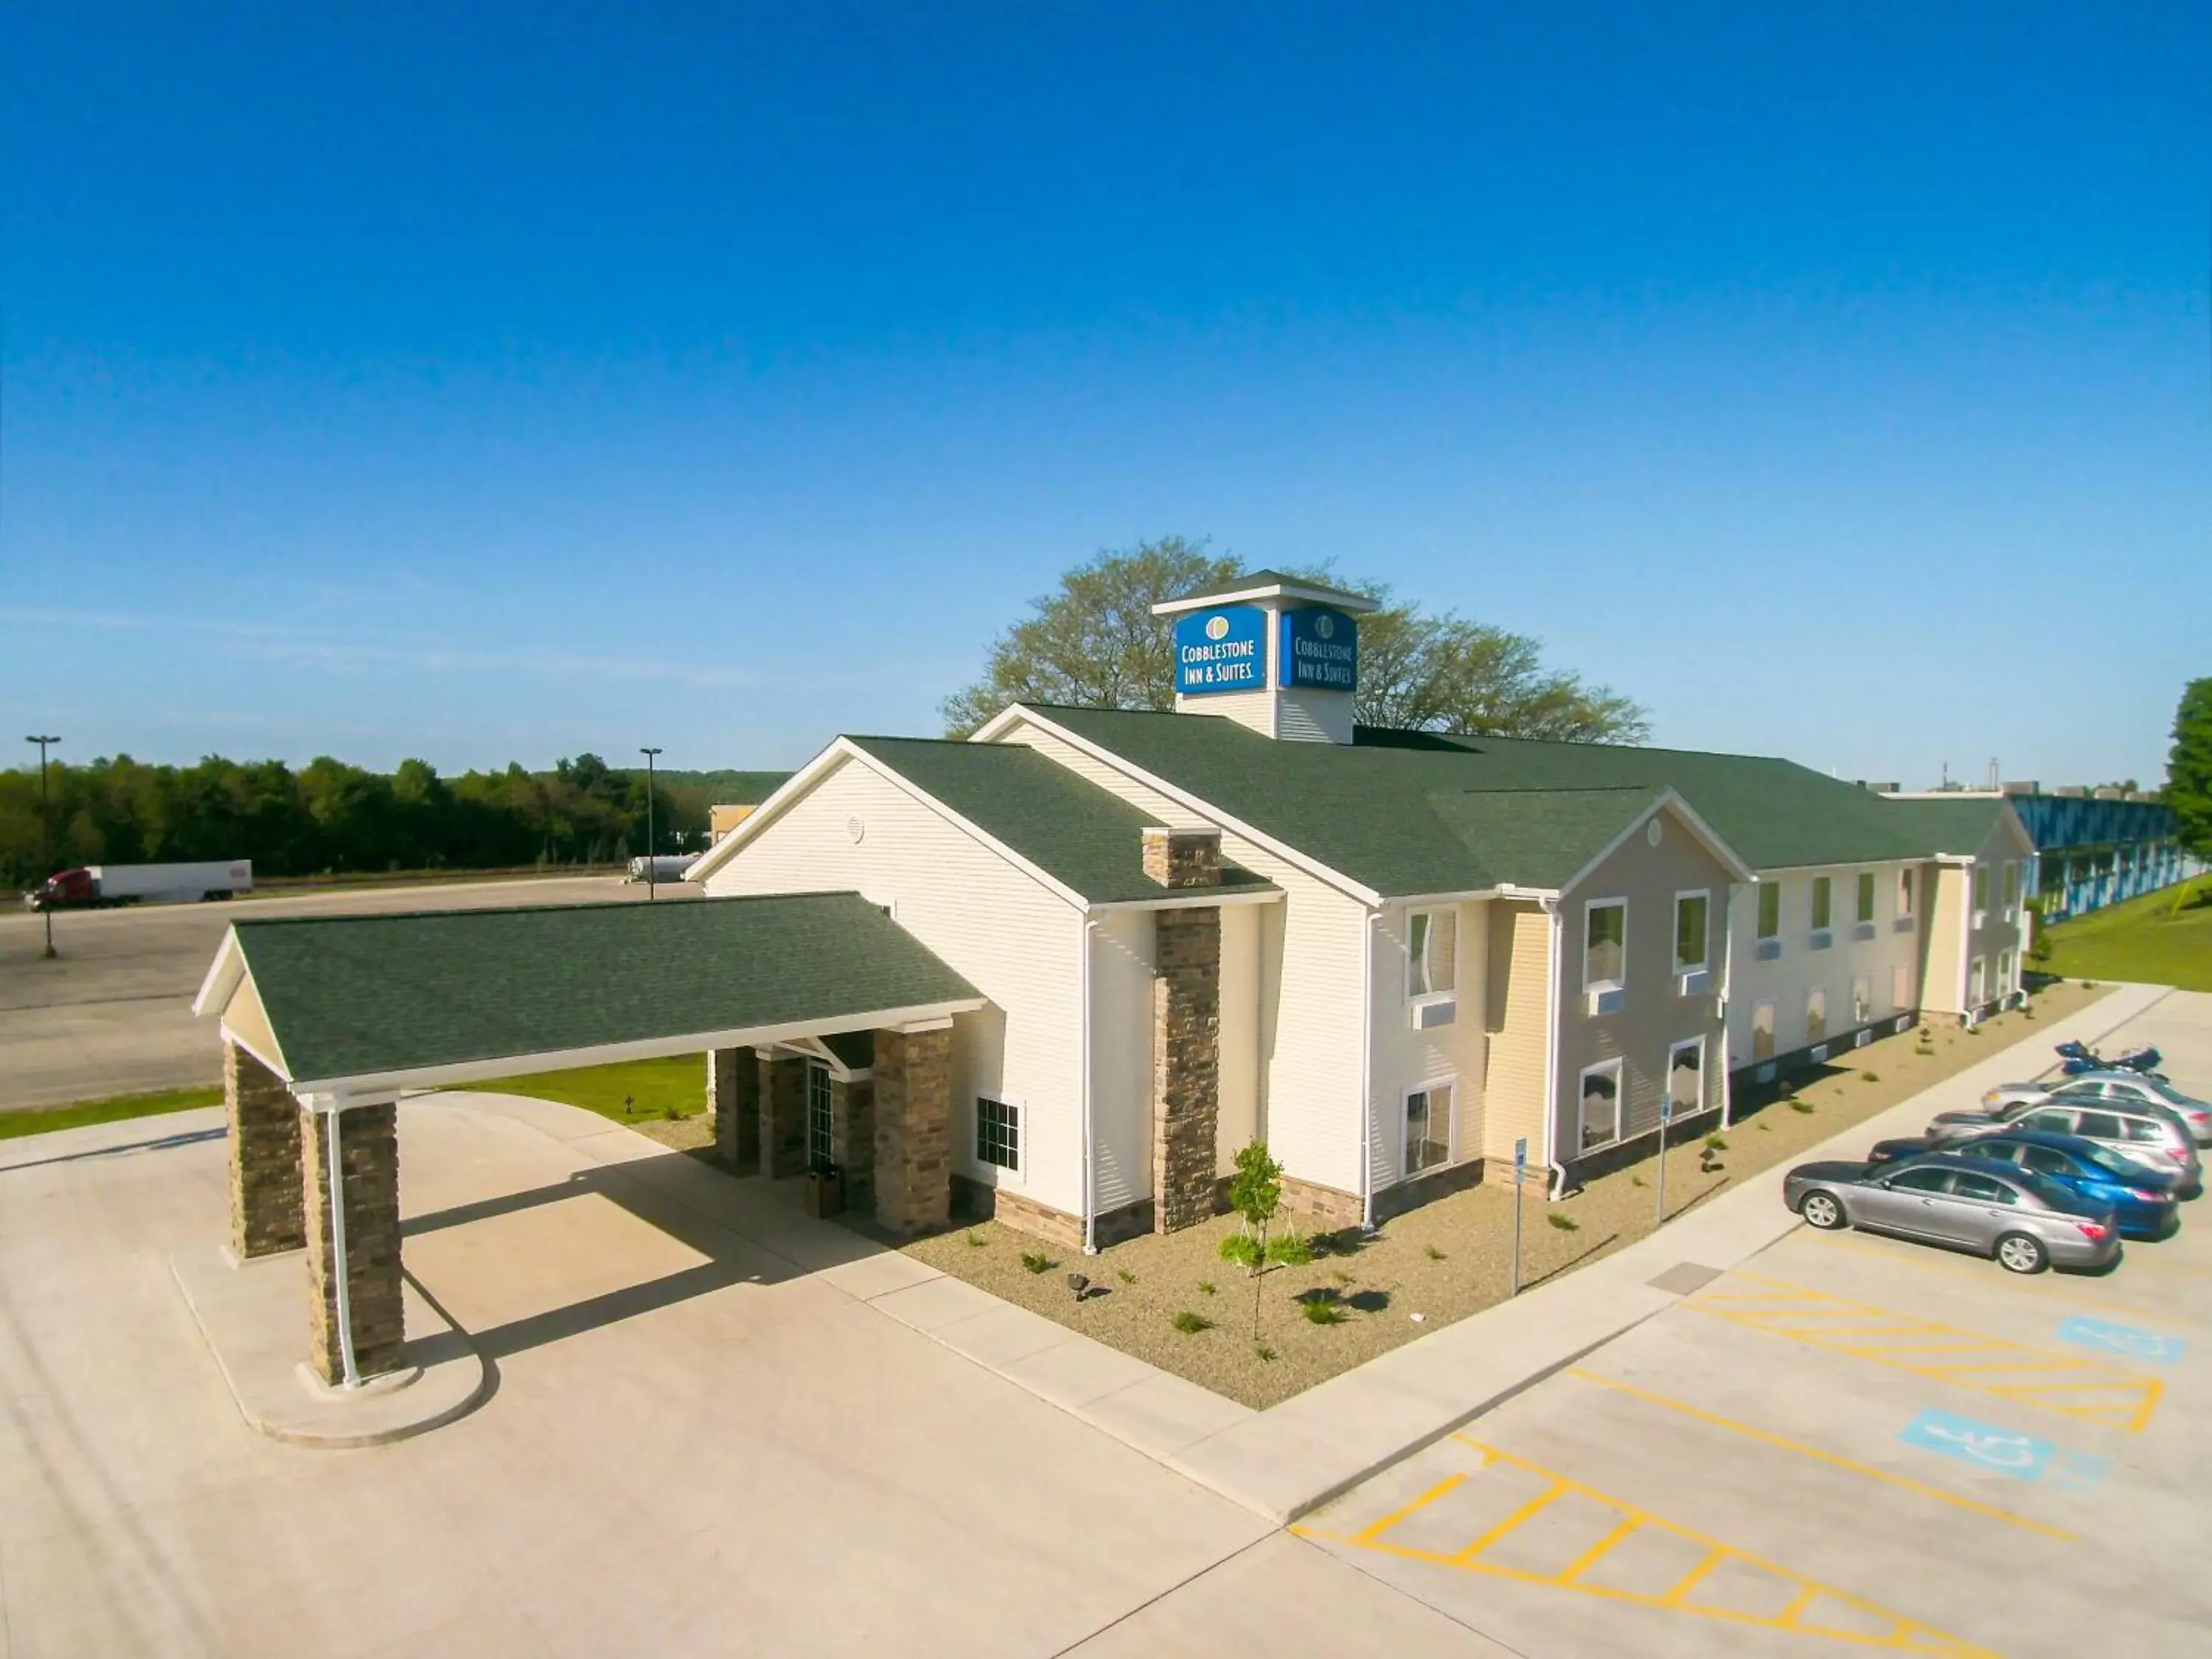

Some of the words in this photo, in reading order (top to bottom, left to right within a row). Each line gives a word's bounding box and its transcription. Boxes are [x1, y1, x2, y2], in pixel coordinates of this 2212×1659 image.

[1182, 639, 1254, 663] COBBLESTONE
[1295, 636, 1352, 661] COBBLESTONE
[1185, 666, 1203, 685] INN
[1206, 666, 1214, 683] &
[1216, 662, 1252, 682] SUITES
[1298, 660, 1314, 679] INN
[1316, 664, 1322, 681] &
